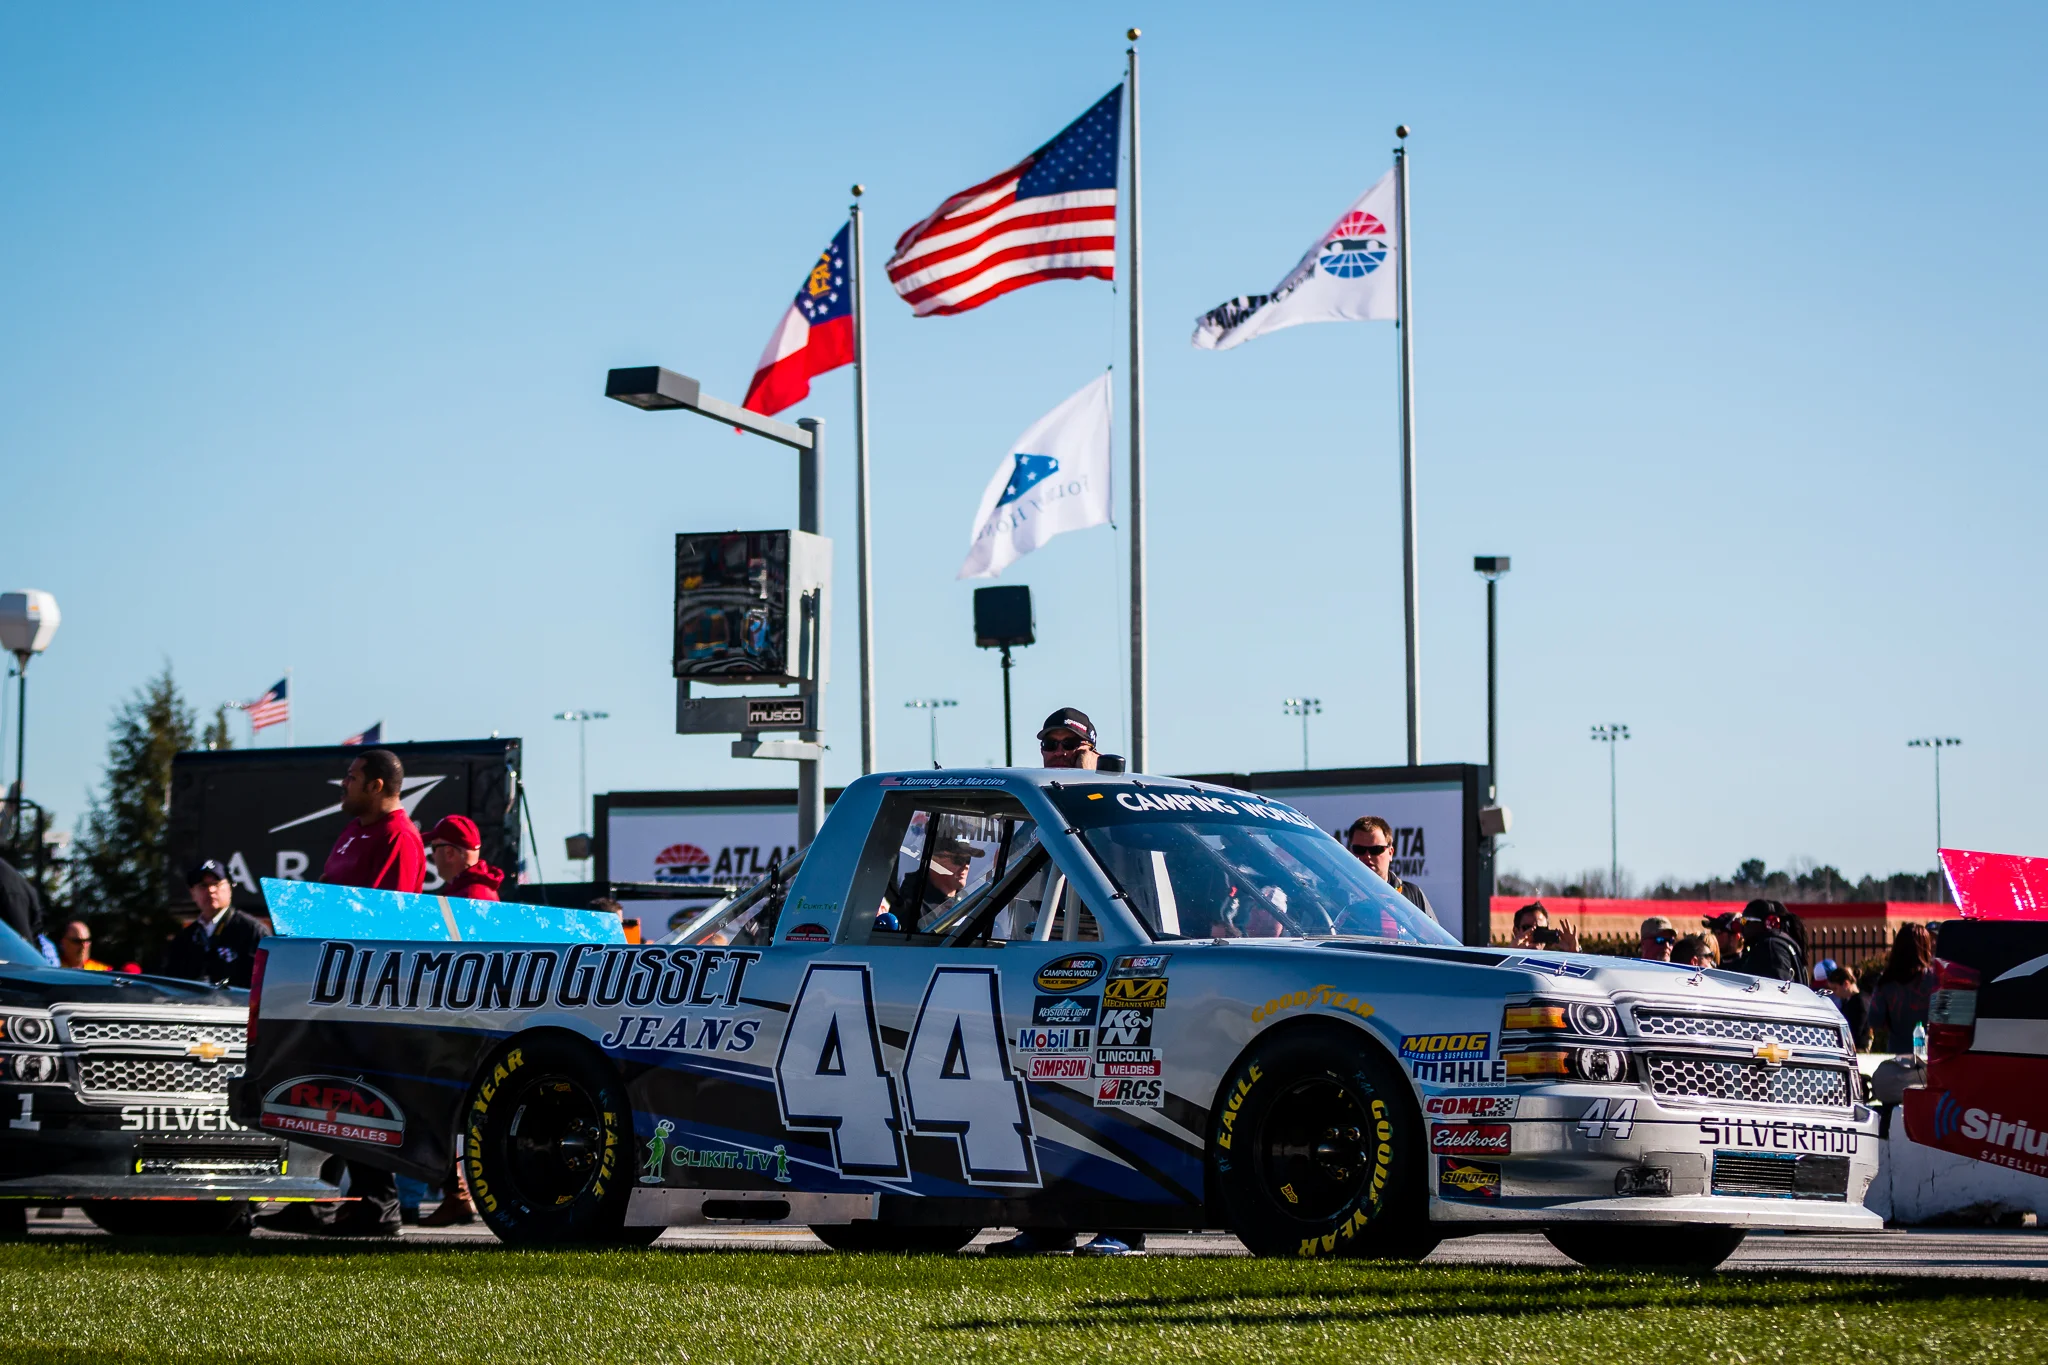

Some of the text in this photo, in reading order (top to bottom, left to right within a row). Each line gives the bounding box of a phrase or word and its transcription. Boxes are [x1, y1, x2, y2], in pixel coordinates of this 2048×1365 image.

[900, 776, 1008, 788] Tommy Joe Martins
[1116, 792, 1316, 831] CAMPING WORLD
[1070, 960, 1096, 969] NASCAR
[1131, 957, 1158, 968] NASCAR
[307, 940, 761, 1013] DIAMOND GUSSET
[1043, 969, 1098, 978] CAMPING WORLD
[1038, 1007, 1092, 1017] KEYSTONE LIGHT
[1103, 999, 1166, 1009] MECHANIX WEAR
[1251, 984, 1375, 1024] GOODYEAR
[600, 1015, 765, 1053] JEANS
[1019, 1029, 1070, 1048] Mobil
[1401, 1034, 1489, 1053] MOOG
[1098, 1050, 1151, 1063] LINCOLN
[1403, 1050, 1436, 1060] STEERING
[1443, 1051, 1484, 1059] SUSPENSION
[772, 960, 1043, 1188] 44
[1032, 1059, 1087, 1077] SIMPSON
[1109, 1065, 1156, 1075] WELDERS
[1412, 1060, 1506, 1083] MAHLE
[1116, 1079, 1162, 1100] RCS
[289, 1082, 386, 1121] RPM
[1135, 1099, 1158, 1107] Spring
[1217, 1060, 1264, 1150] EAGLE
[1426, 1097, 1497, 1115] COMP
[9, 1093, 41, 1132] 1
[1472, 1109, 1506, 1117] CAMS
[1577, 1098, 1638, 1140] 44
[276, 1116, 389, 1143] TRAILER SALES
[1432, 1129, 1509, 1148] Edelbrock
[1699, 1117, 1858, 1154] SILVERADO
[1961, 1108, 2048, 1157] Siriu
[591, 1111, 618, 1202] EAGLE
[671, 1145, 773, 1170] CLIKIT.TV
[1441, 1171, 1499, 1186] SUNOCO
